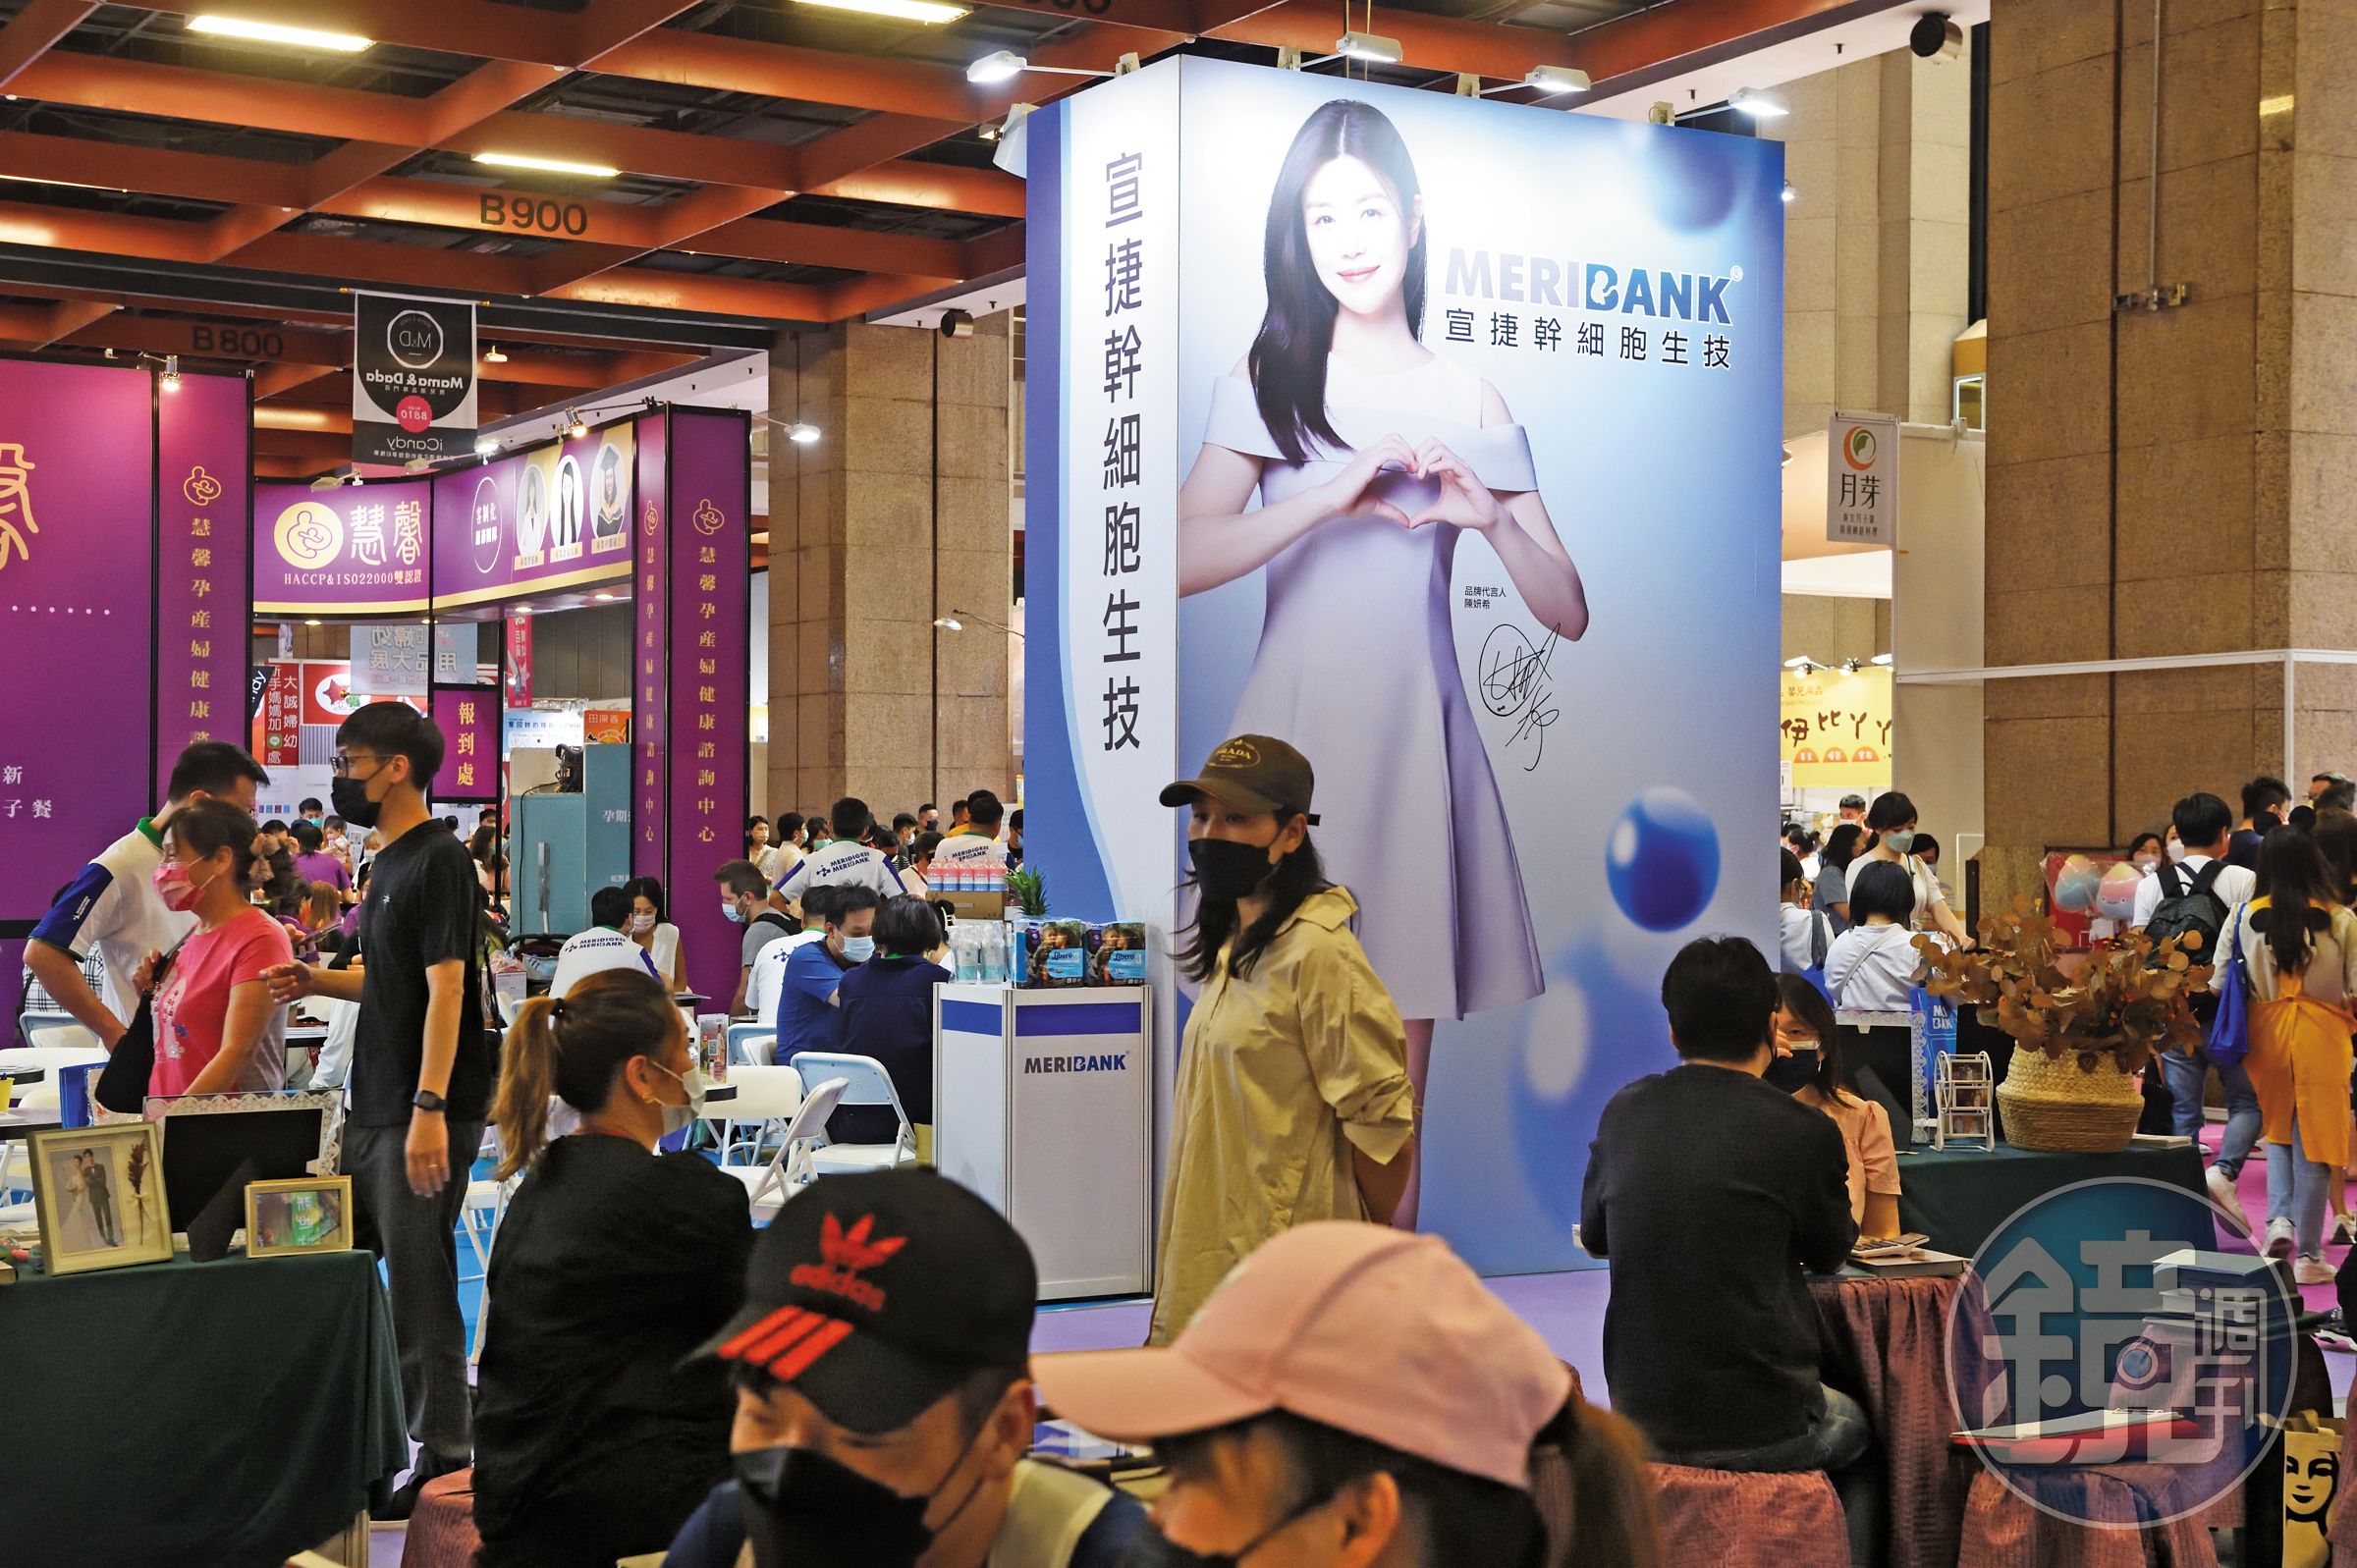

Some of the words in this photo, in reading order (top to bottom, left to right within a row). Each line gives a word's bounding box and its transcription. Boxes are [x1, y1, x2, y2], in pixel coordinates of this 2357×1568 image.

[1444, 246, 1733, 326] MERIBANK
[1445, 307, 1732, 370] 宣捷幹細胞生技
[1102, 152, 1143, 752] 宣捷幹細胞生技
[1838, 473, 1882, 510] 月芽
[350, 500, 423, 567] 慧馨
[1464, 586, 1507, 598] 品牌代言人
[1464, 598, 1491, 610] 陳妍希
[283, 676, 298, 748] 大誠婦幼
[2, 764, 24, 785] 新
[457, 702, 475, 786] 報到處
[1024, 1054, 1126, 1074] MERIBANK
